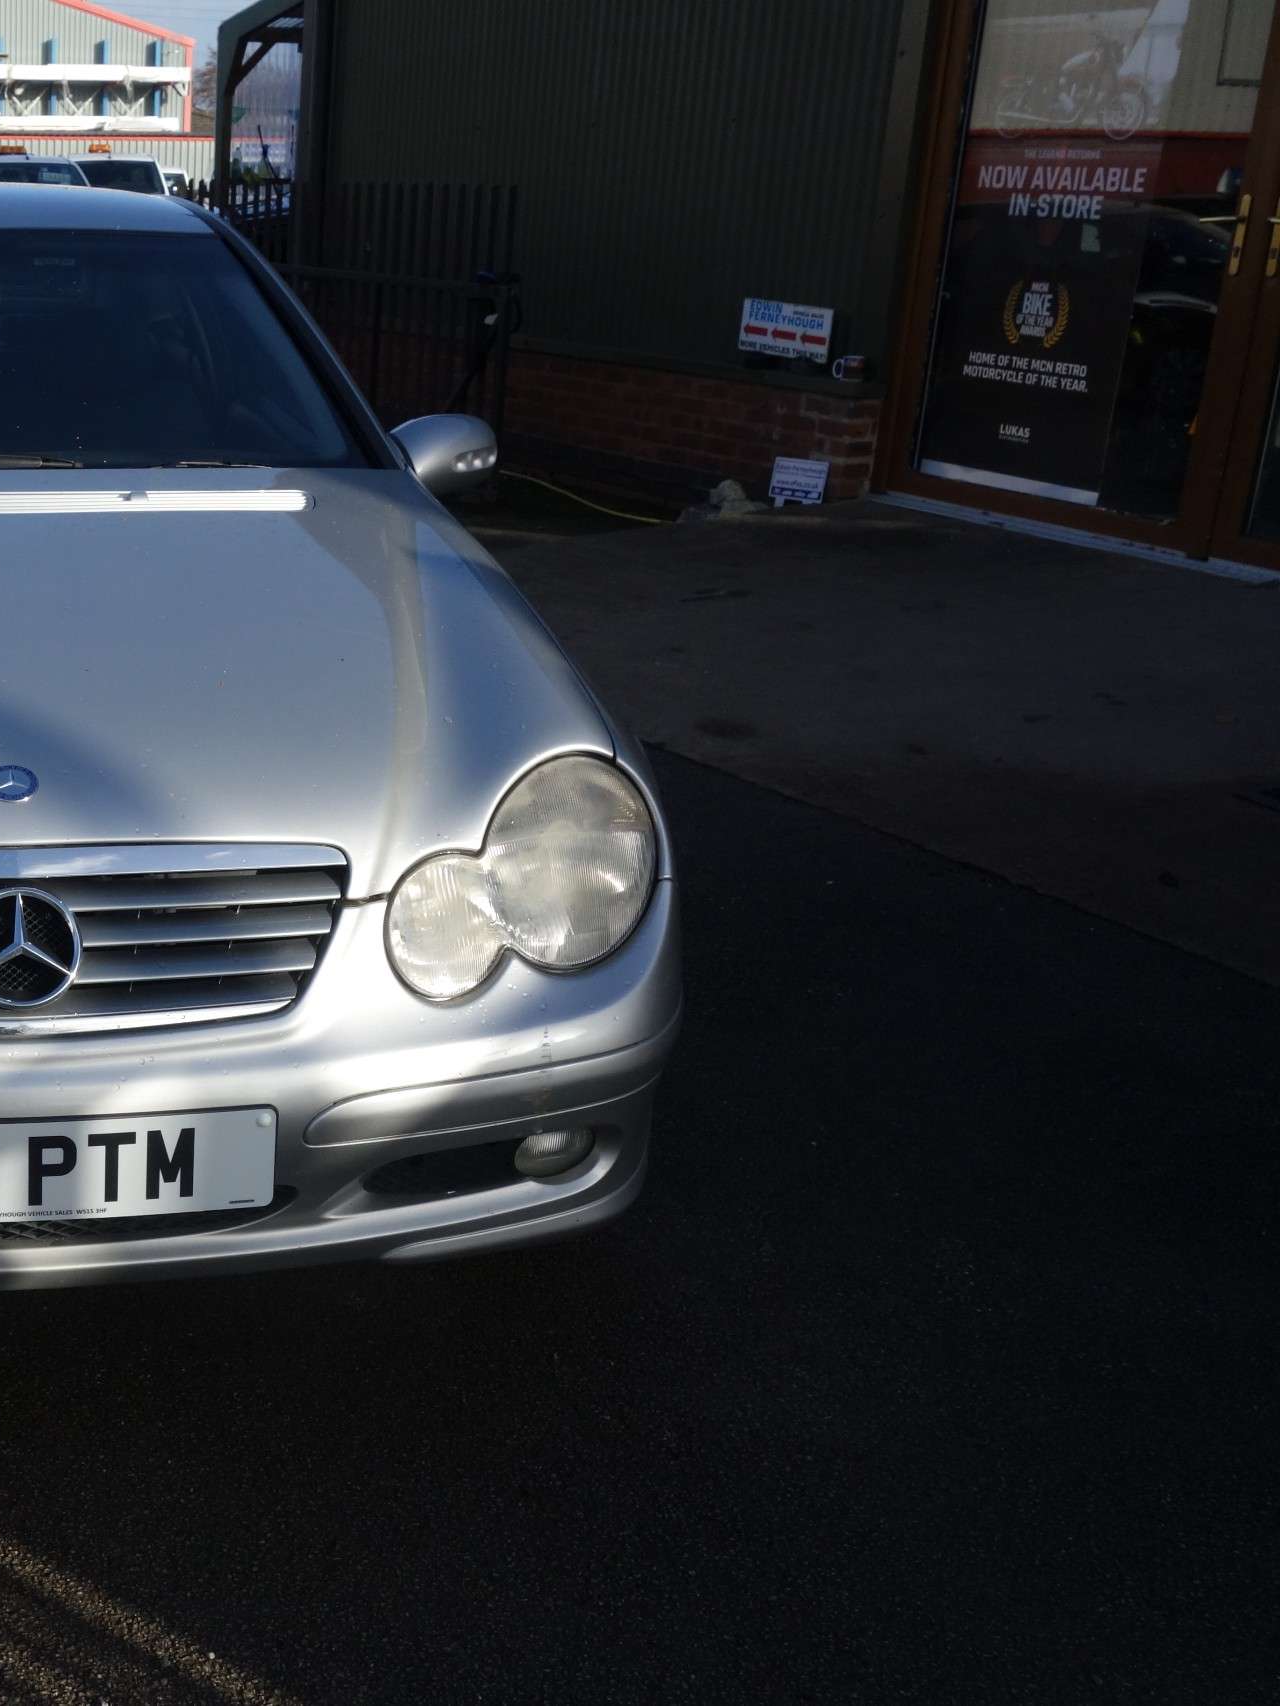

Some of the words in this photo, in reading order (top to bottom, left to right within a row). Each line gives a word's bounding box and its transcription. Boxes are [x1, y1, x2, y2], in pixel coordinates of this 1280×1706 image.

[978, 165, 1028, 189] NOW
[1031, 166, 1148, 193] AVAILABLE
[1007, 192, 1105, 220] IN-STORE
[749, 300, 783, 314] EDWIN
[1022, 292, 1053, 316] BIKE
[748, 311, 825, 330] FERNEYHOUGH
[968, 351, 997, 365] HOME
[997, 354, 1010, 367] OF
[1012, 356, 1029, 369] THE
[1030, 359, 1055, 373] MCN
[1055, 362, 1088, 377] RETRO
[963, 364, 1024, 384] MOTORCYCLE
[1025, 373, 1039, 385] OF
[1040, 375, 1058, 388] THE
[1060, 378, 1089, 392] YEAR.
[1000, 424, 1031, 438] LUKAS
[28, 1128, 196, 1207] PTM
